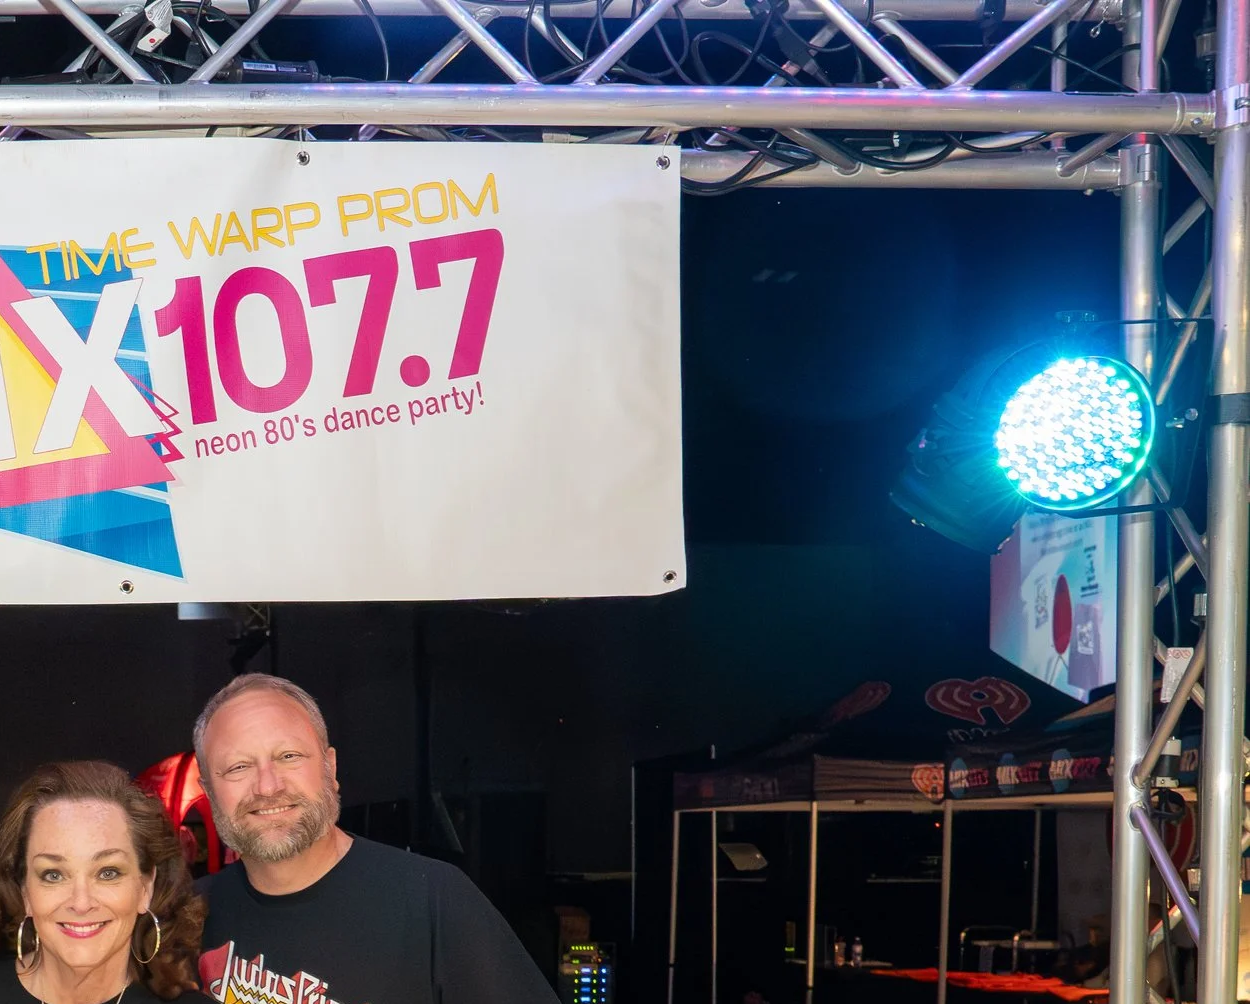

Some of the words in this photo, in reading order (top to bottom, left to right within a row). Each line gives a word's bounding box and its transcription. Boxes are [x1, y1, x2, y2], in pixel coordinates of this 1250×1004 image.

[26, 228, 156, 284] TIME
[167, 202, 321, 259] WARP
[337, 173, 499, 237] PROM
[155, 228, 505, 424] 107.7
[195, 429, 257, 458] neon
[263, 415, 317, 445] 80's
[323, 406, 401, 433] dance
[407, 381, 485, 426] party!
[210, 940, 295, 1004] Judas
